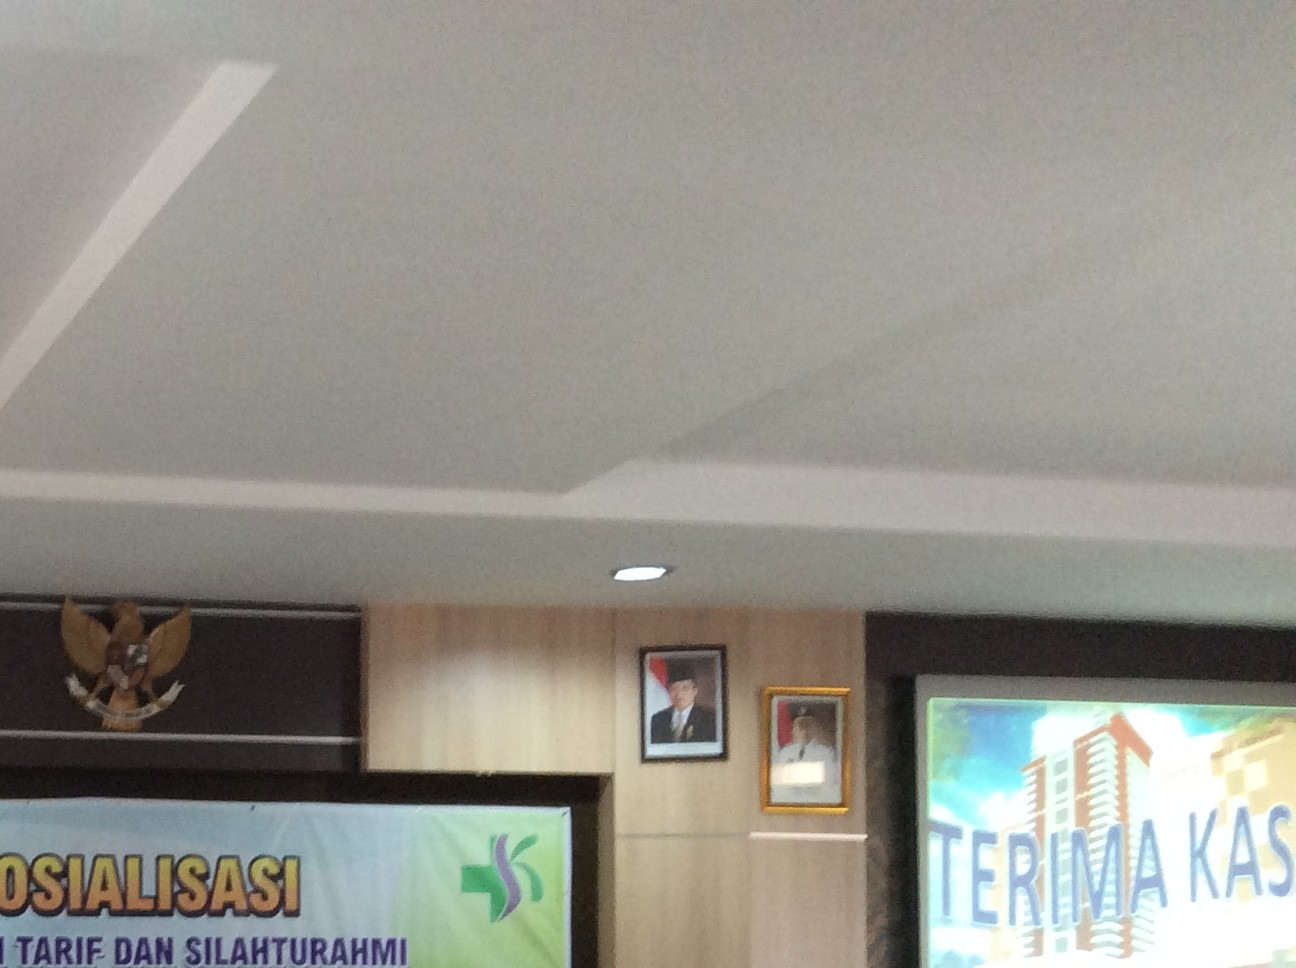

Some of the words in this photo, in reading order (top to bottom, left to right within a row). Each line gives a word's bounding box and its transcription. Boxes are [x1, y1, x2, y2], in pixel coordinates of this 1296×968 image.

[929, 819, 1168, 926] TERIMA
[1188, 803, 1296, 902] KAS
[16, 935, 105, 968] TARIF
[114, 936, 175, 968] DAN
[185, 936, 409, 968] SILAHTURAHMI
